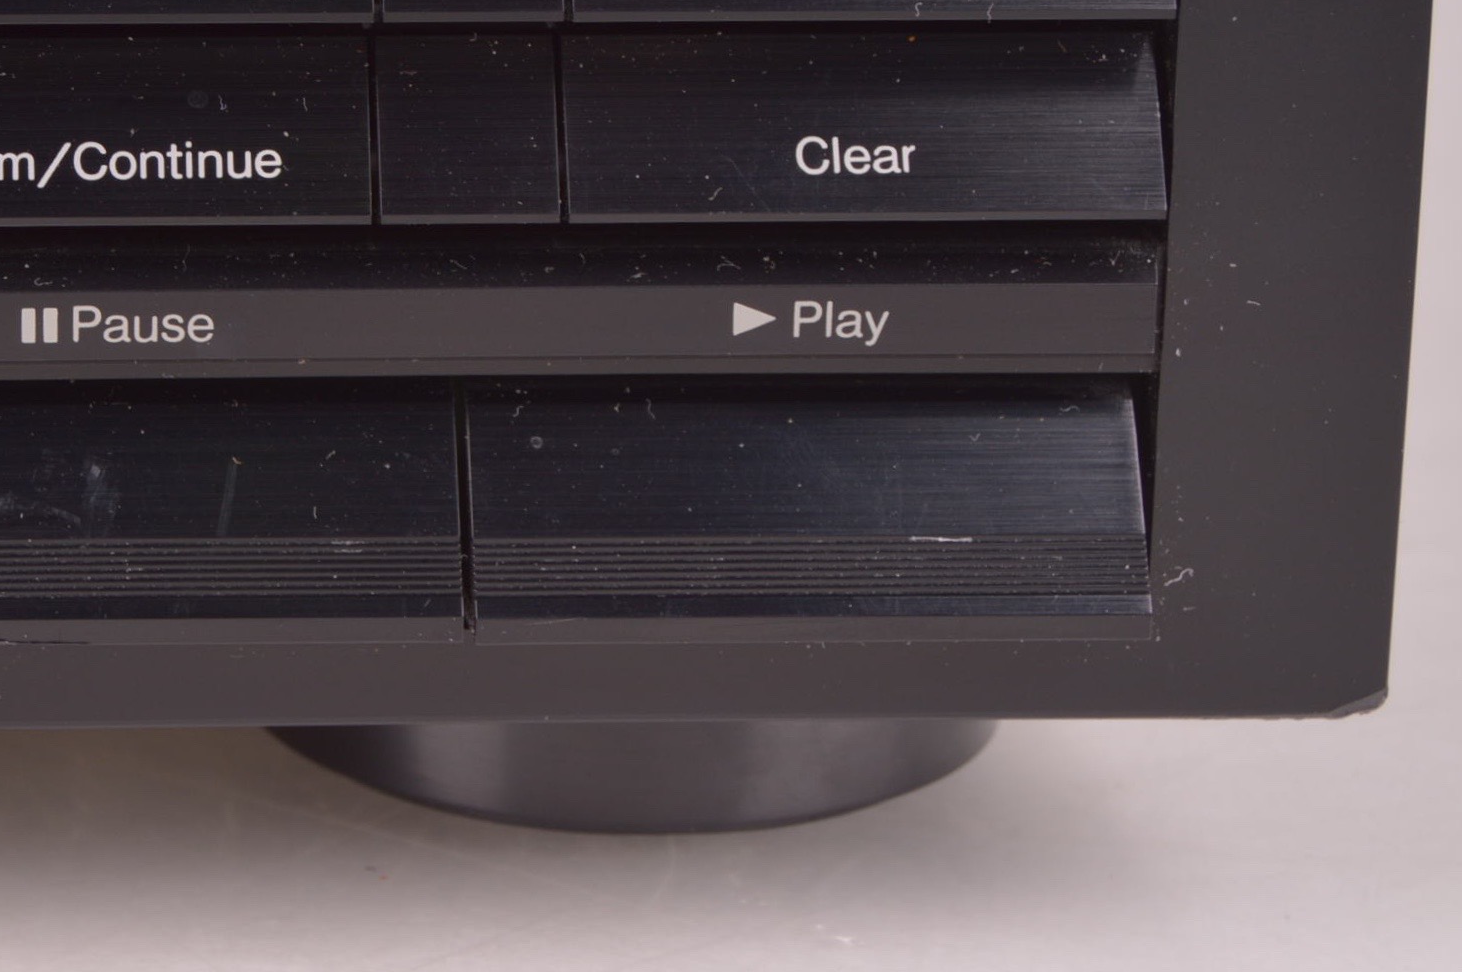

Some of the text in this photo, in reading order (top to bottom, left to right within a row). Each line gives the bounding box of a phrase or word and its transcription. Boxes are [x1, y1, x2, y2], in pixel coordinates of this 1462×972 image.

[795, 135, 916, 176] Clear
[71, 304, 215, 344] Pause
[792, 300, 890, 347] Play
